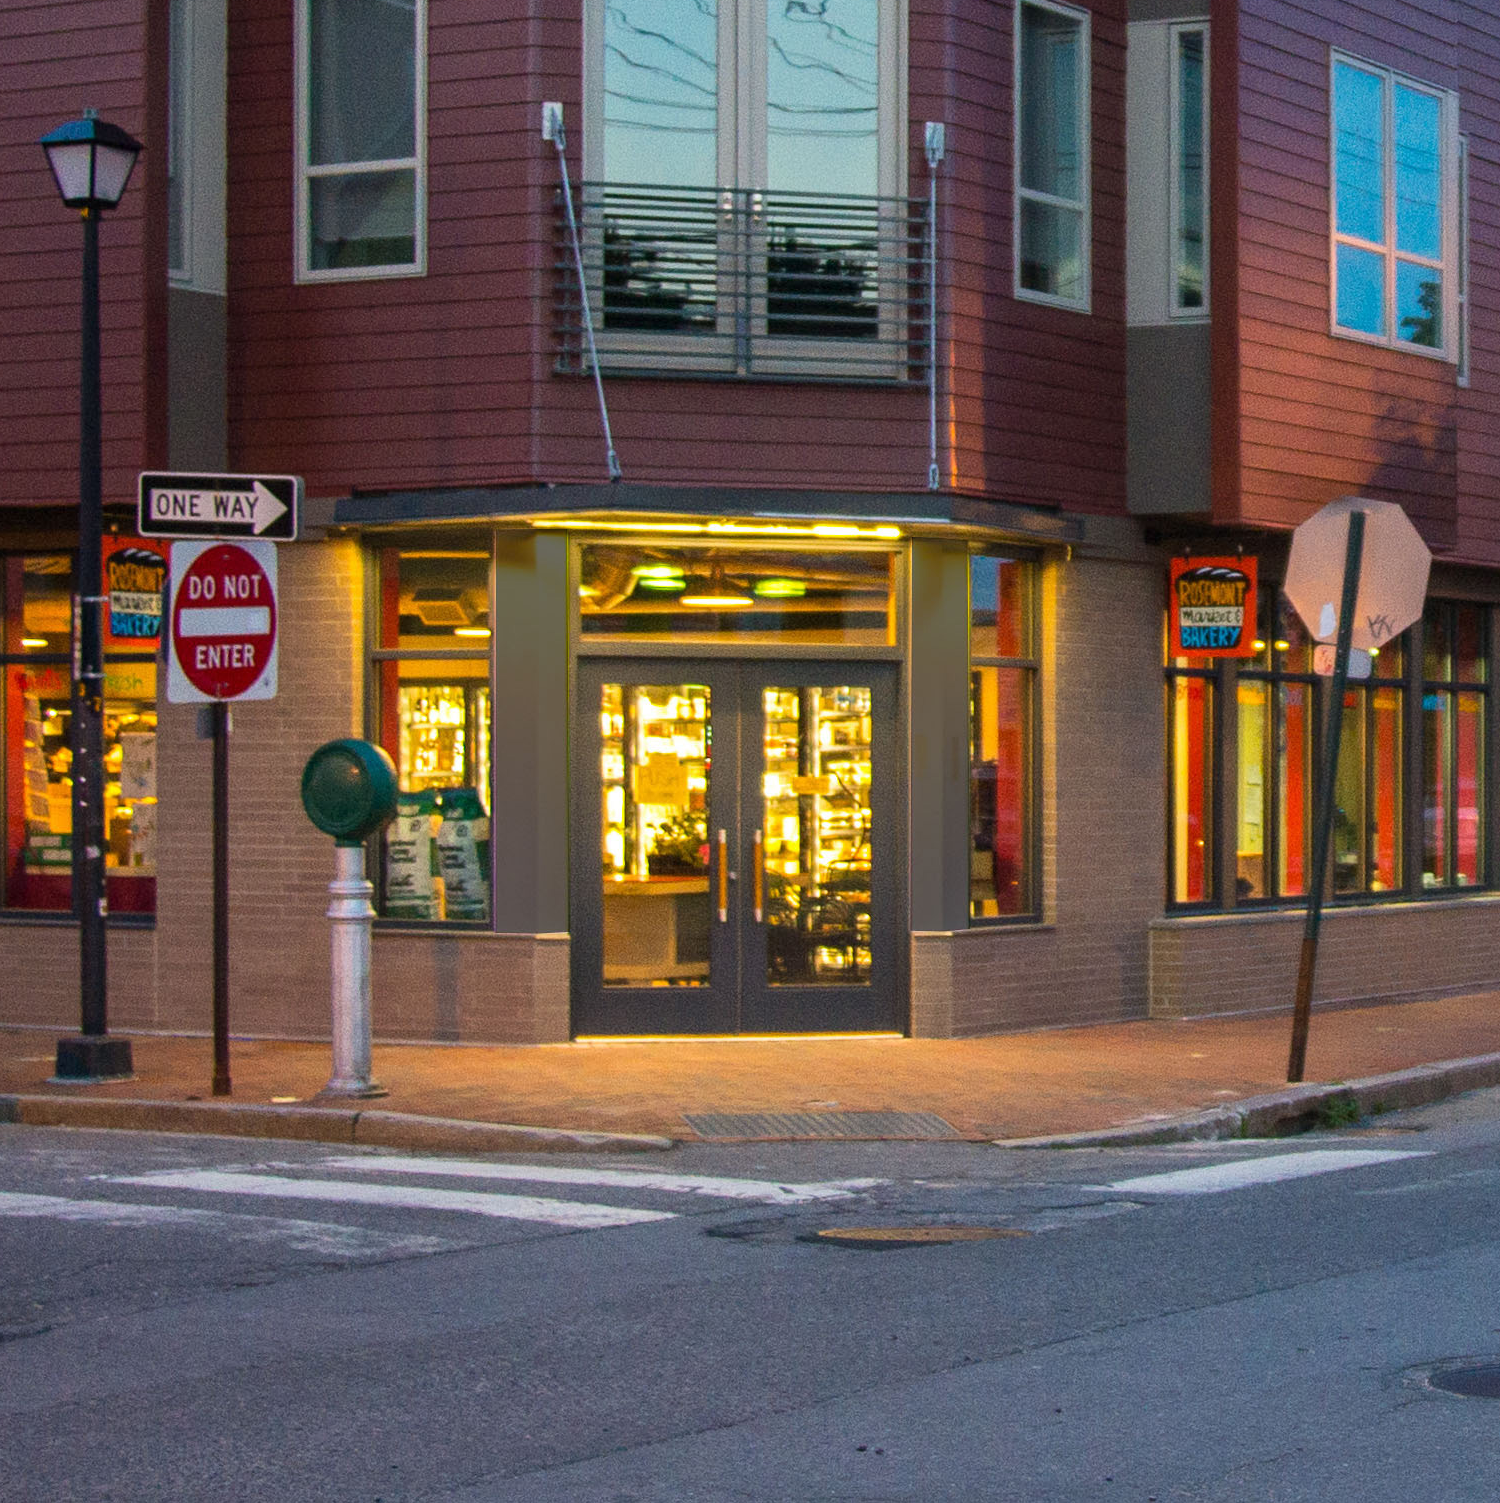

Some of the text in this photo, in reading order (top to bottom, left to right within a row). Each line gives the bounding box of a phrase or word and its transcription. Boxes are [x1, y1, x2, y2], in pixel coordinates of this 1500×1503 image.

[156, 493, 259, 519] ONE WAY
[189, 574, 261, 600] DO NOT
[1179, 580, 1246, 606] ROSEMONT
[111, 613, 161, 635] BAKERY
[1182, 627, 1241, 647] BAKERY
[195, 644, 255, 669] ENTER
